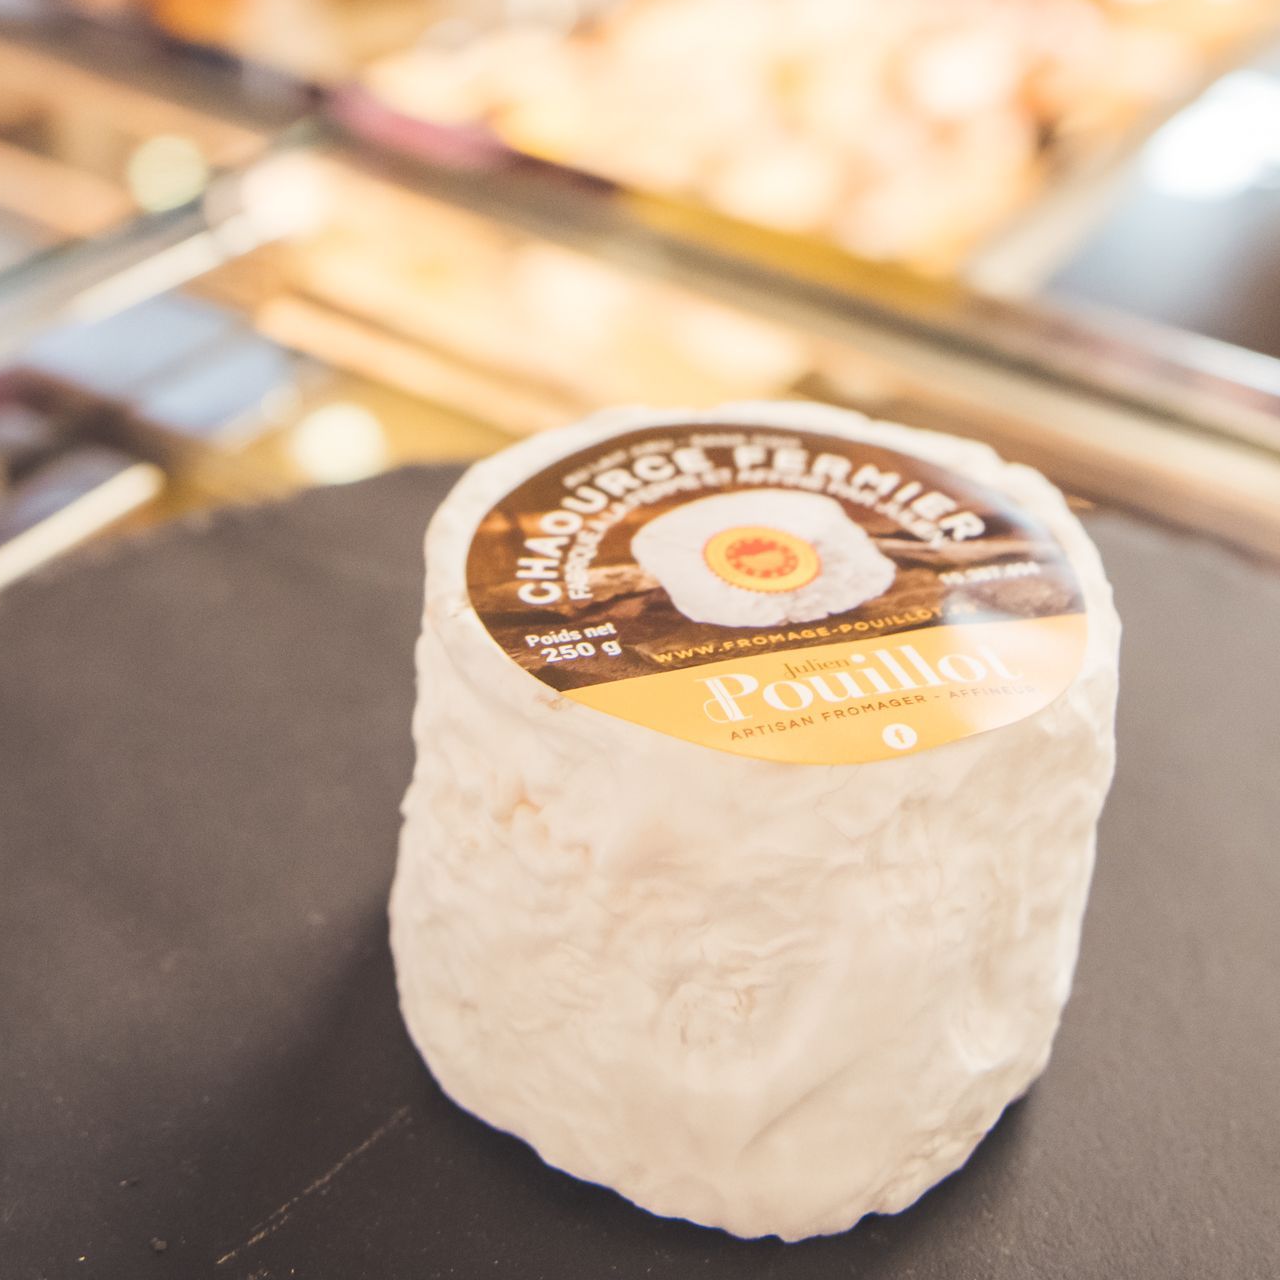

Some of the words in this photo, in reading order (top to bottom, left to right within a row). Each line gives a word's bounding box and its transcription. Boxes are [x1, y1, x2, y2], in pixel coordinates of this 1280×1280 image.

[515, 446, 715, 605] CHAOURCE
[733, 444, 986, 542] FERMIER
[524, 629, 582, 648] Poids
[584, 621, 618, 639] net
[540, 642, 596, 663] 250
[600, 639, 622, 657] g
[693, 644, 1024, 725] Pouillot
[783, 657, 850, 680] Julien
[730, 715, 815, 741] ARTISAN
[821, 694, 927, 721] FROMAGER
